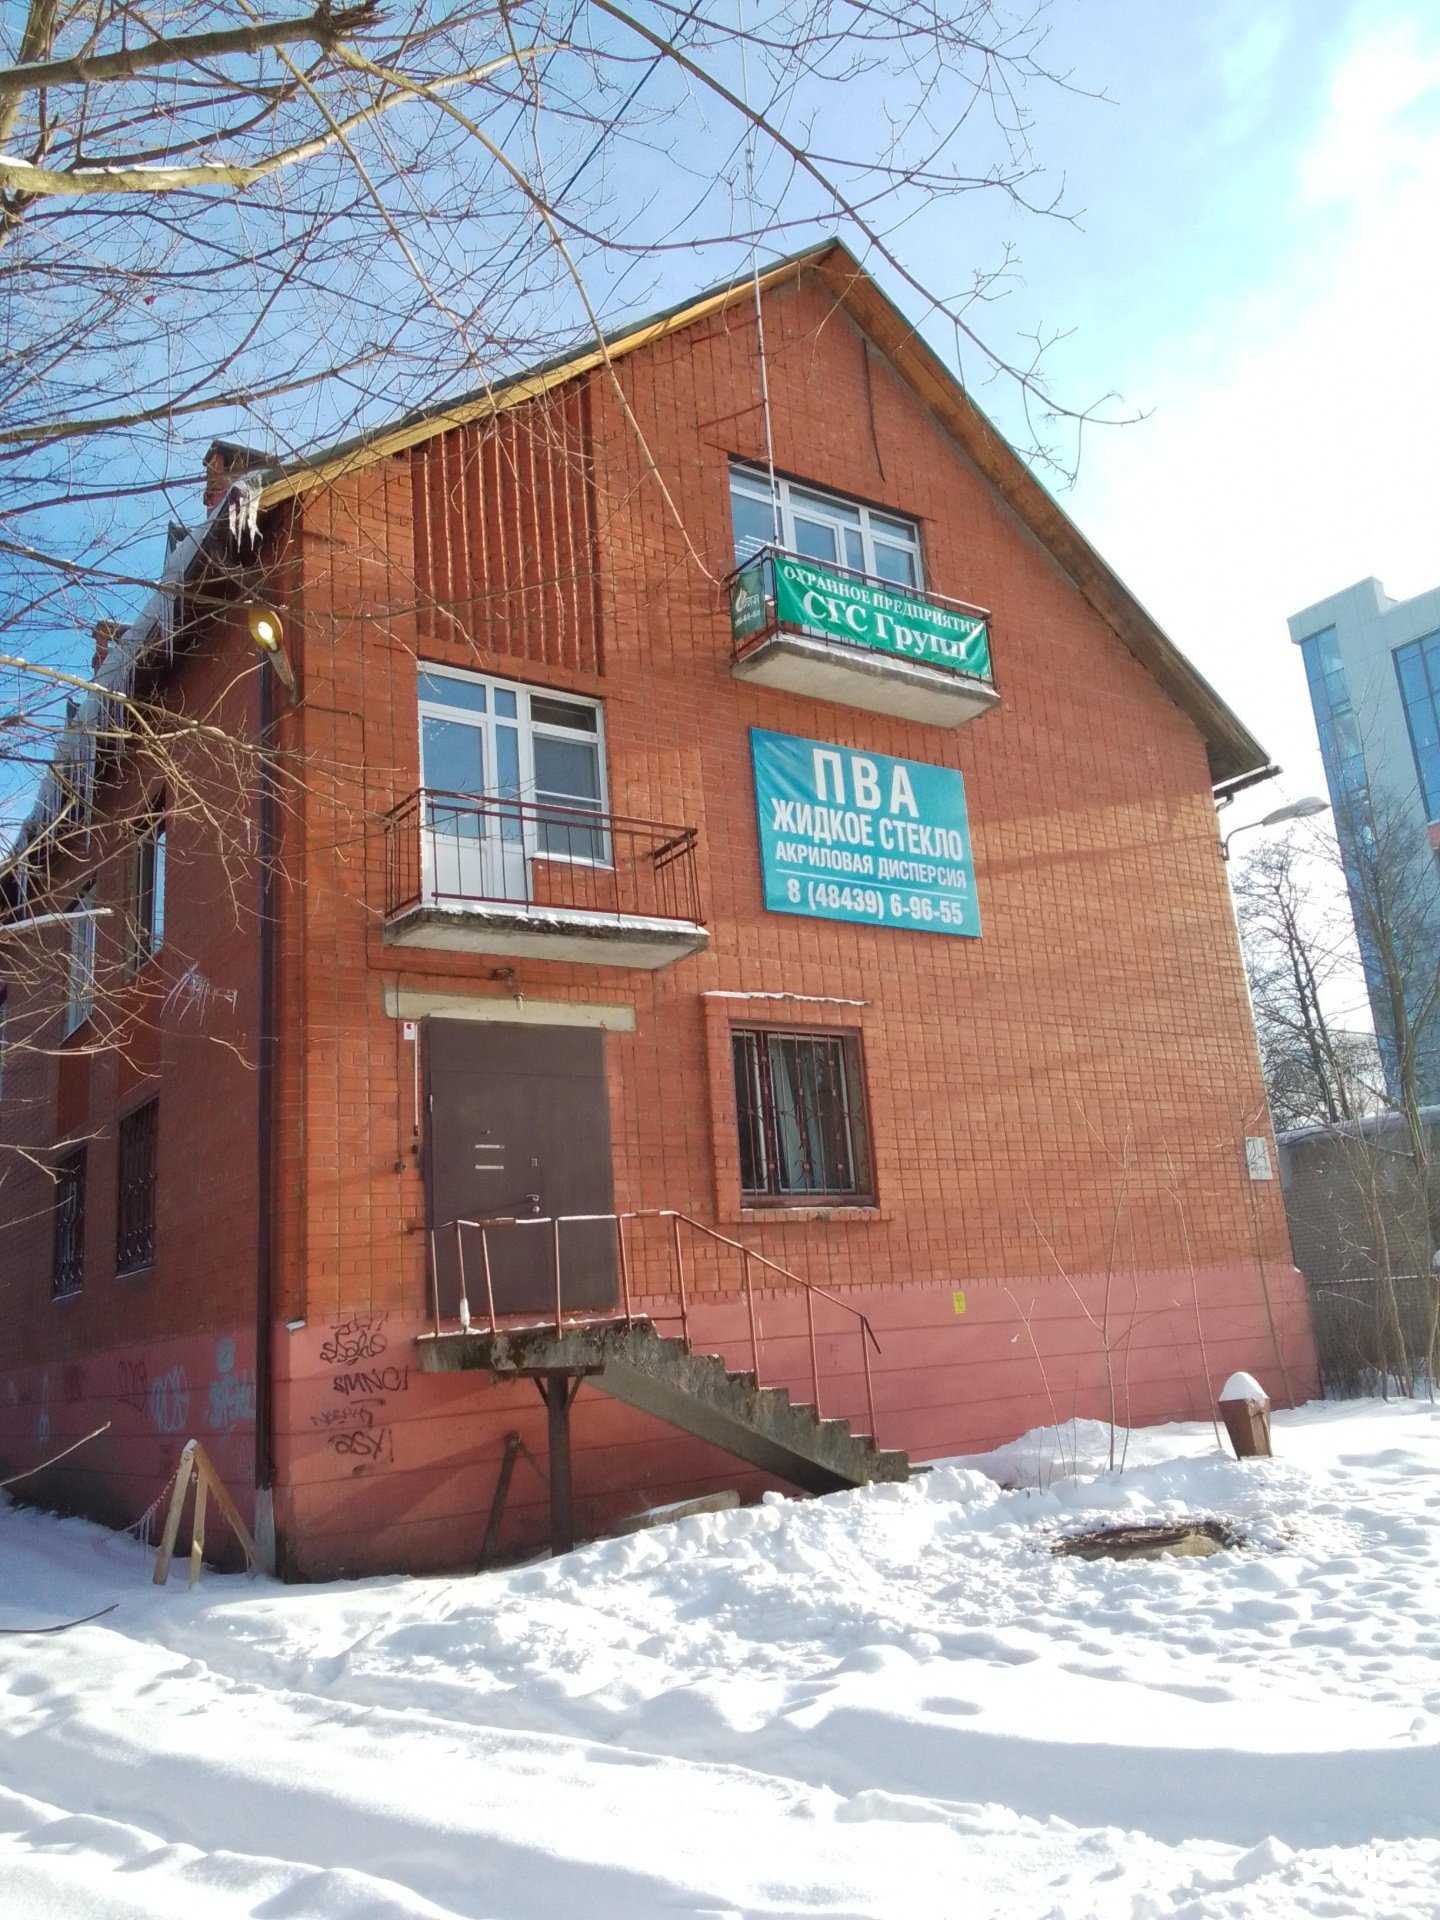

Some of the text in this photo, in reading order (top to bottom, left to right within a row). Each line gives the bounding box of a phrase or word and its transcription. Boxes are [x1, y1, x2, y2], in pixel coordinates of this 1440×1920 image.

[783, 565, 871, 605] ОХРАННОЕ
[802, 590, 868, 632] СГС
[812, 748, 920, 818] ПВА
[771, 798, 964, 861] ЖИДКОЕ СТЕКЛО
[775, 840, 967, 889] АКРИЛОВАЯ ДИСПЕРСИЯ
[786, 878, 964, 925] 8 (48439) 6-96-55
